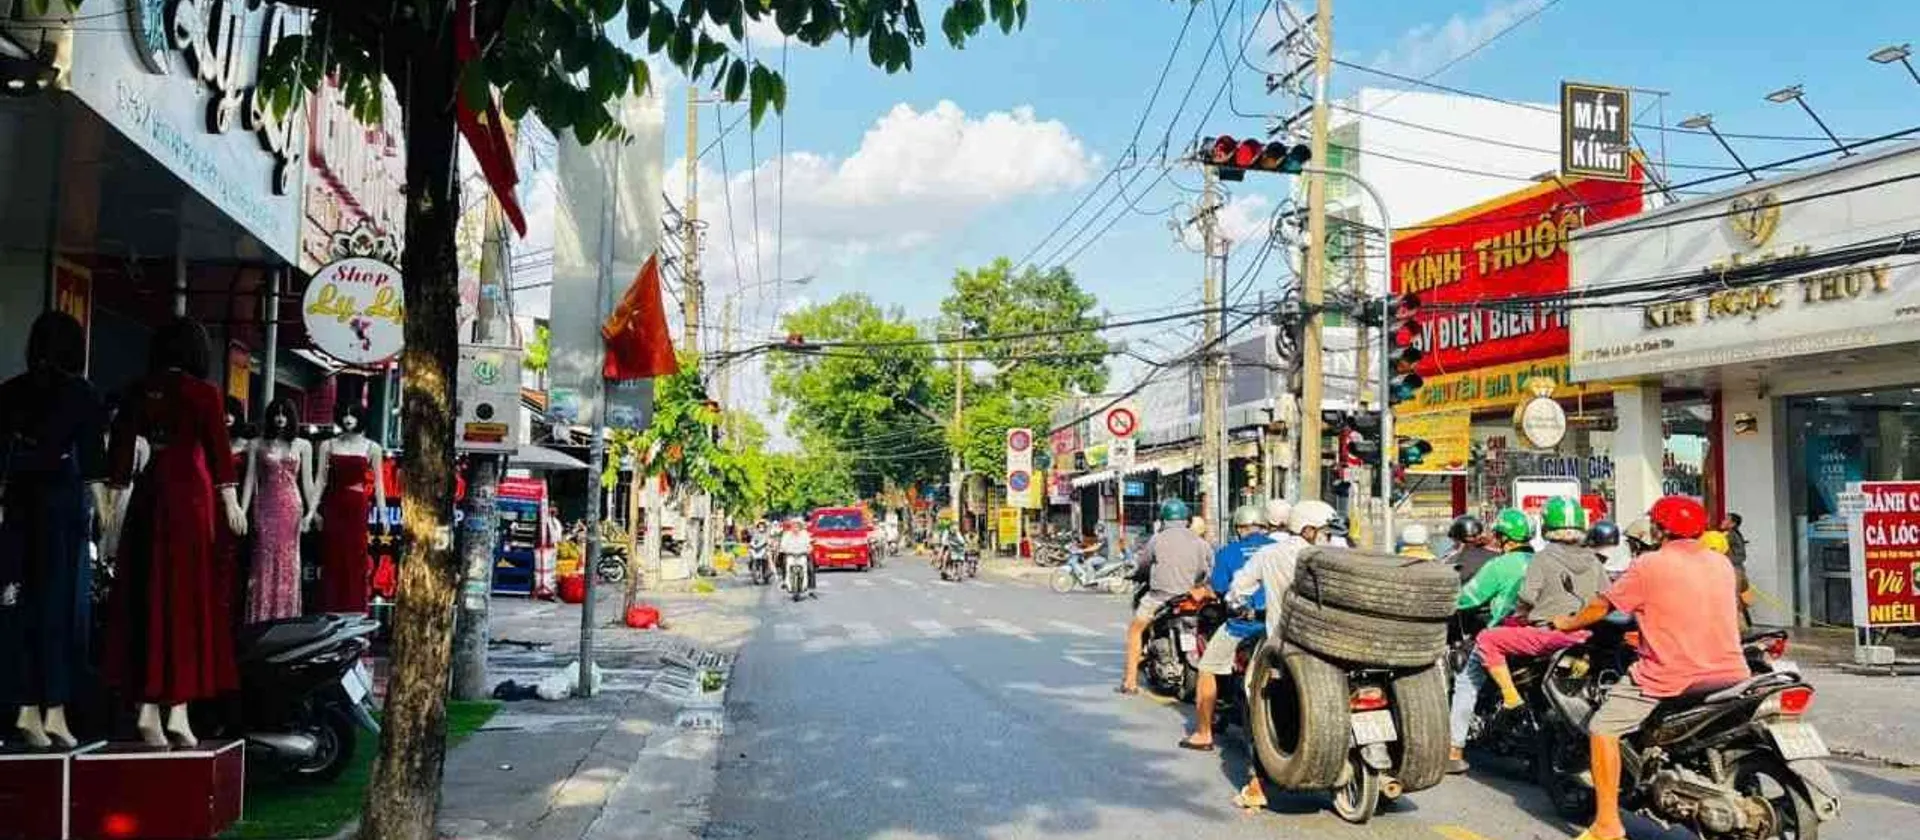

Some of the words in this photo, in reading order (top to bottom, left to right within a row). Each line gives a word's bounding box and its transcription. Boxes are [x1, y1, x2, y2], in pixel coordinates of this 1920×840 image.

[1573, 134, 1622, 170] KÍNH
[331, 266, 389, 286] Shop
[1401, 247, 1461, 294] KÍNH
[306, 284, 357, 323] Ly
[1866, 519, 1889, 546] CÁ
[1890, 519, 1919, 546] LÓC
[1868, 567, 1905, 596] Vũ
